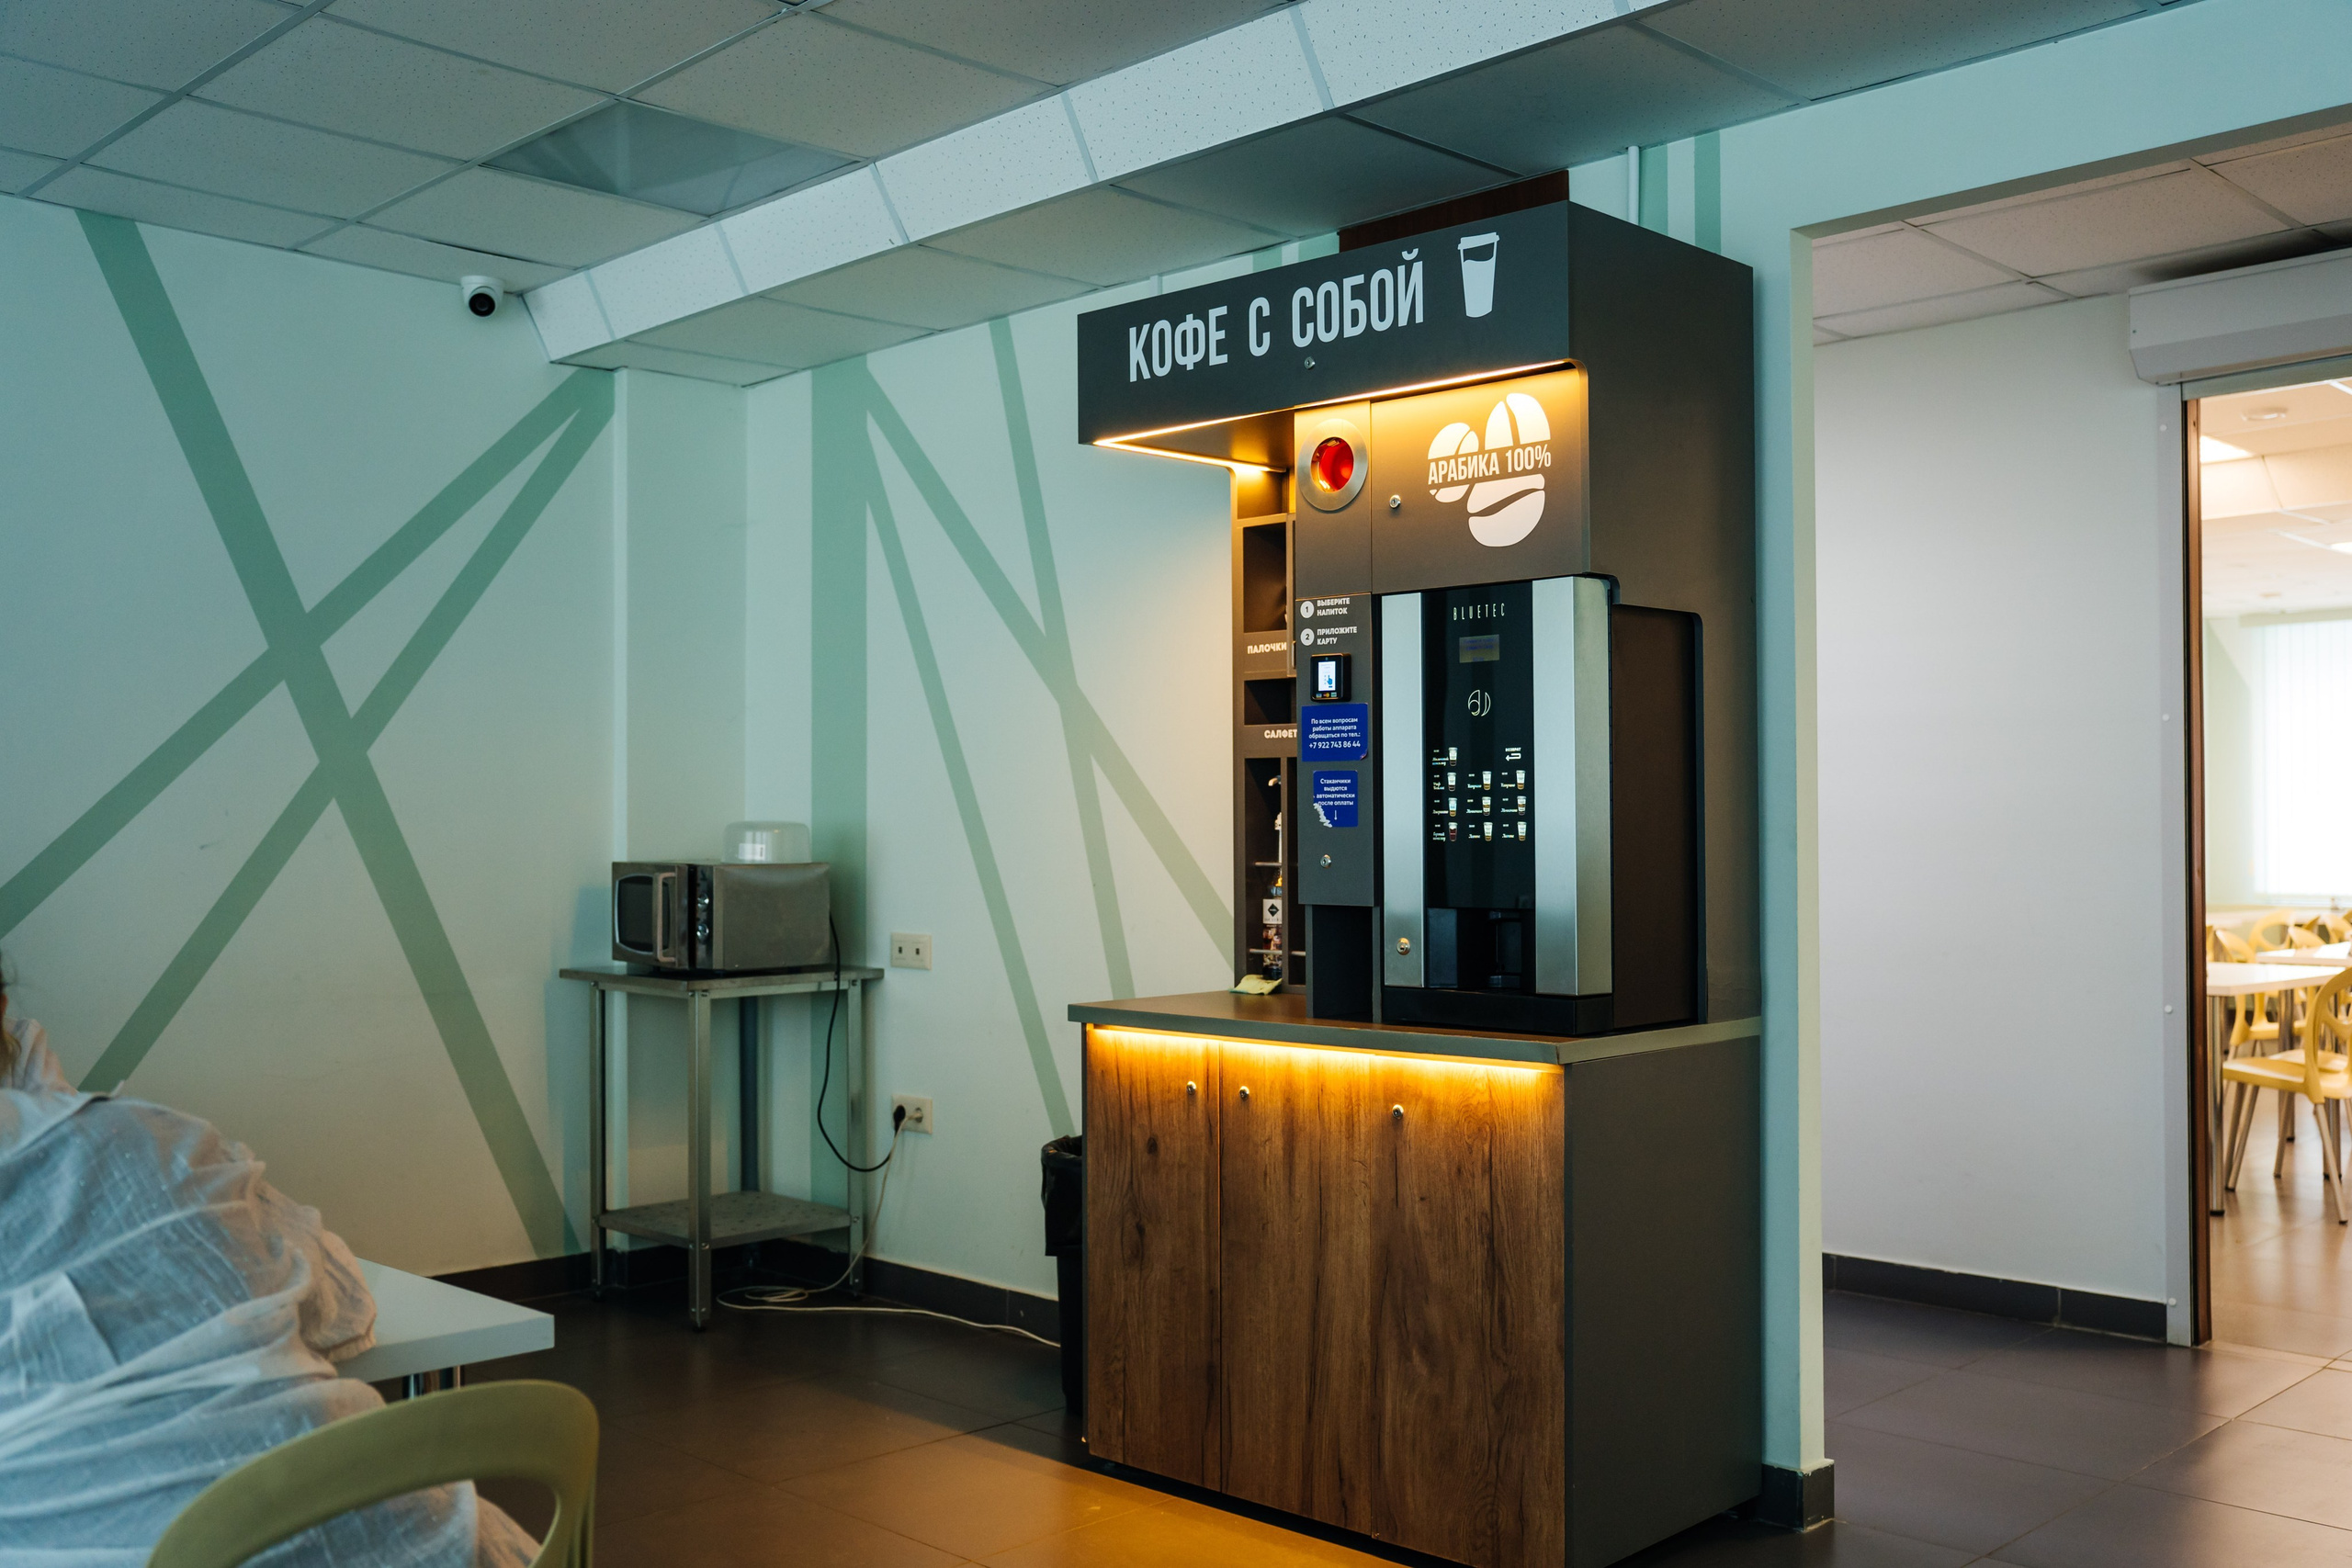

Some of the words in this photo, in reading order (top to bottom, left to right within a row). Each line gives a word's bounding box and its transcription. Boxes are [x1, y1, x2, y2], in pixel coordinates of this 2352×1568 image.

[1129, 305, 1228, 383] КОФЕ
[1249, 297, 1271, 357] С
[1292, 248, 1424, 348] СОБОЙ
[1428, 452, 1500, 485] АРАБИКА
[1505, 444, 1552, 473] 100%
[1317, 598, 1351, 606] ВЫБЕРИТЕ
[1317, 607, 1348, 616] НАПИТОК
[1453, 603, 1505, 621] BLUETEC
[1317, 626, 1358, 636] ПРИЛОЖИТЕ
[1317, 637, 1338, 646] КАРТУ
[1247, 642, 1287, 654] ПАЛОЧКИ
